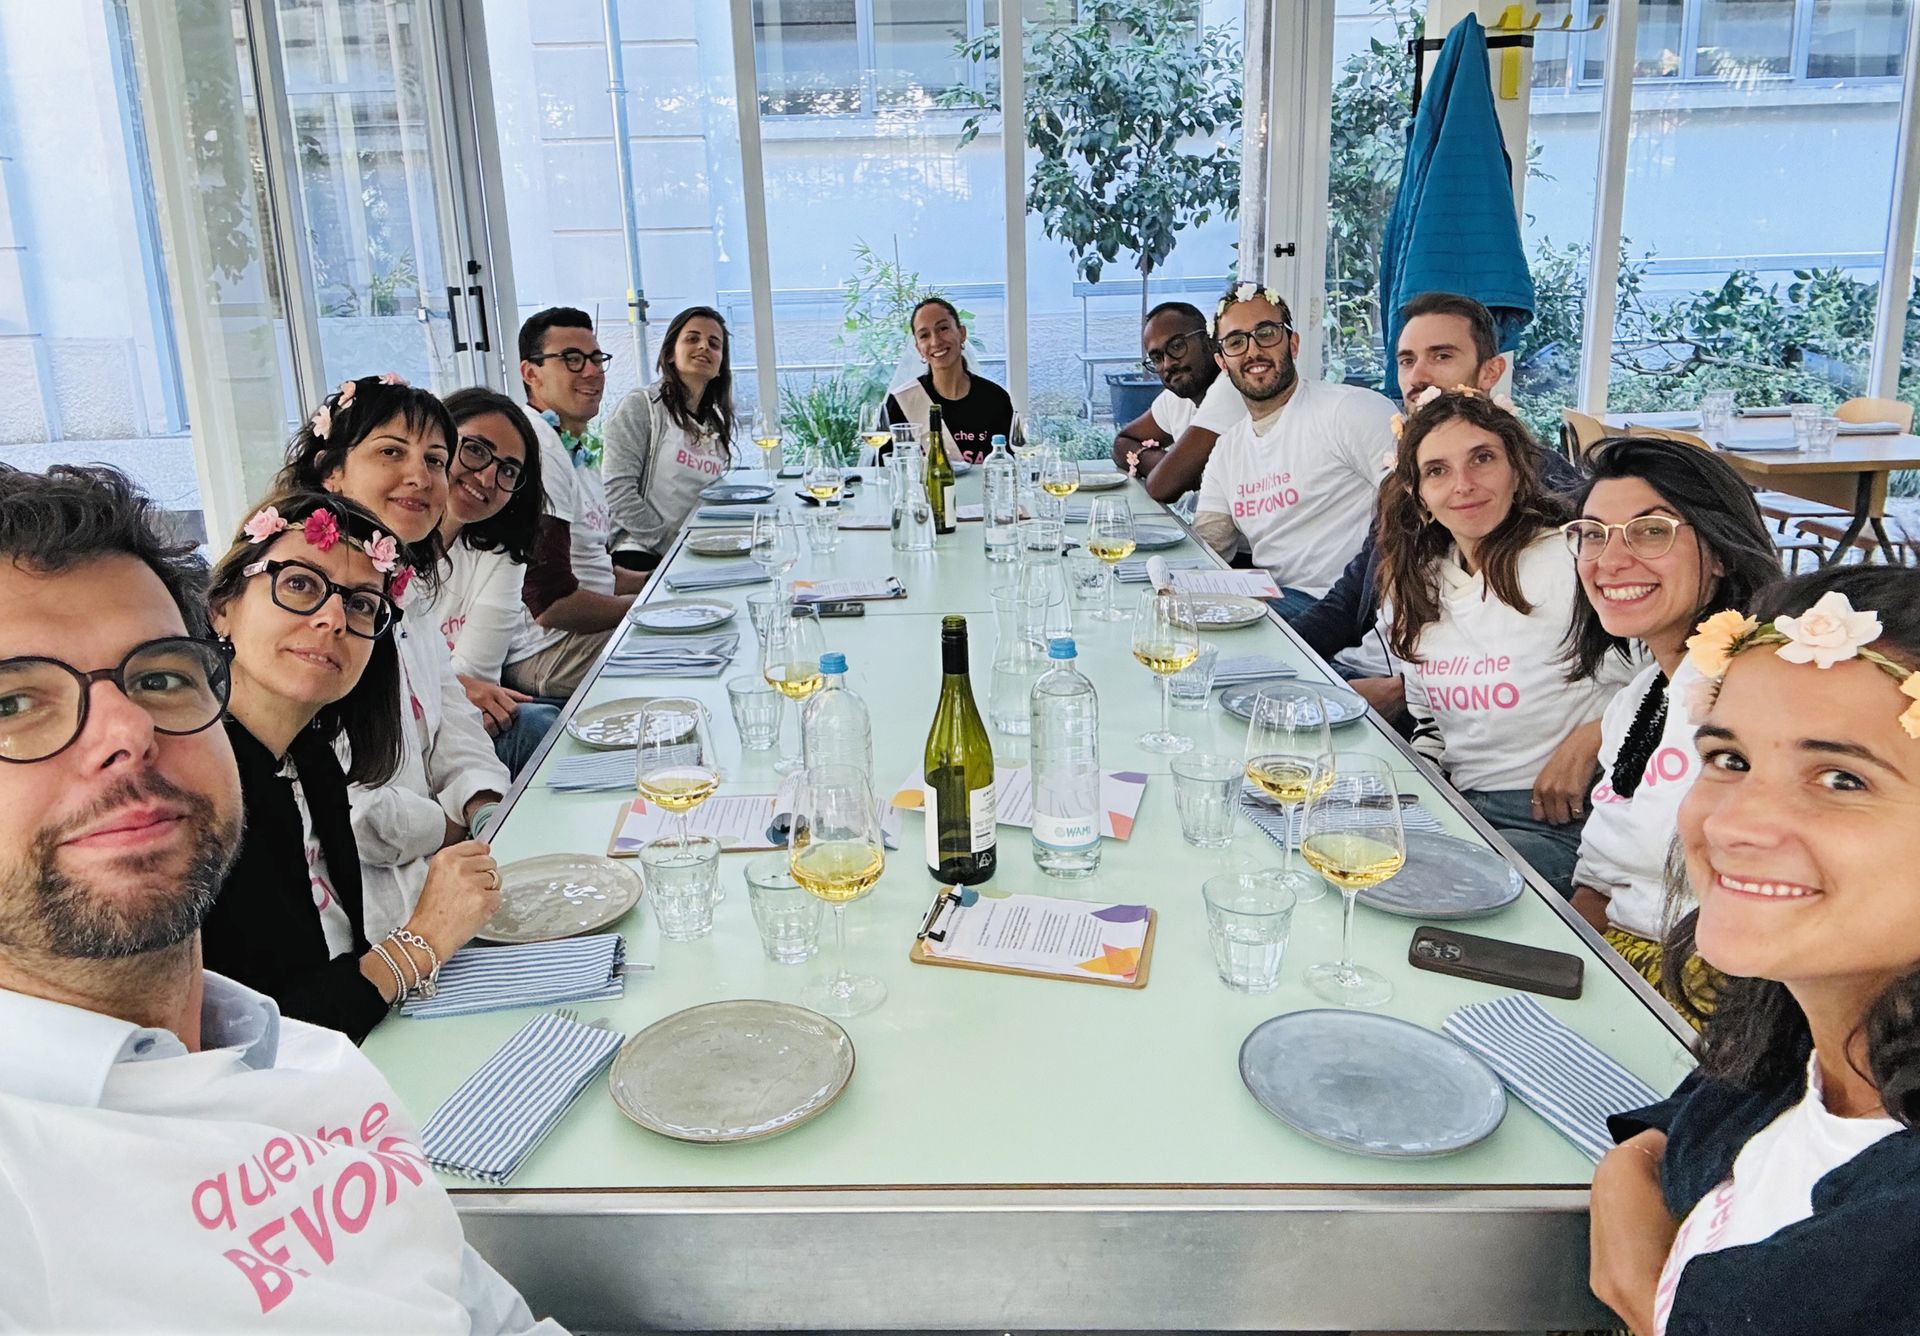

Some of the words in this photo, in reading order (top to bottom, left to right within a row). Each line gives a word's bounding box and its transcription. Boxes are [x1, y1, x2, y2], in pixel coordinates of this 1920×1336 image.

[954, 430, 975, 441] che
[676, 449, 721, 475] BEVON
[1234, 488, 1299, 517] BEVONO
[1473, 653, 1511, 676] che
[1426, 682, 1520, 711] EVONO
